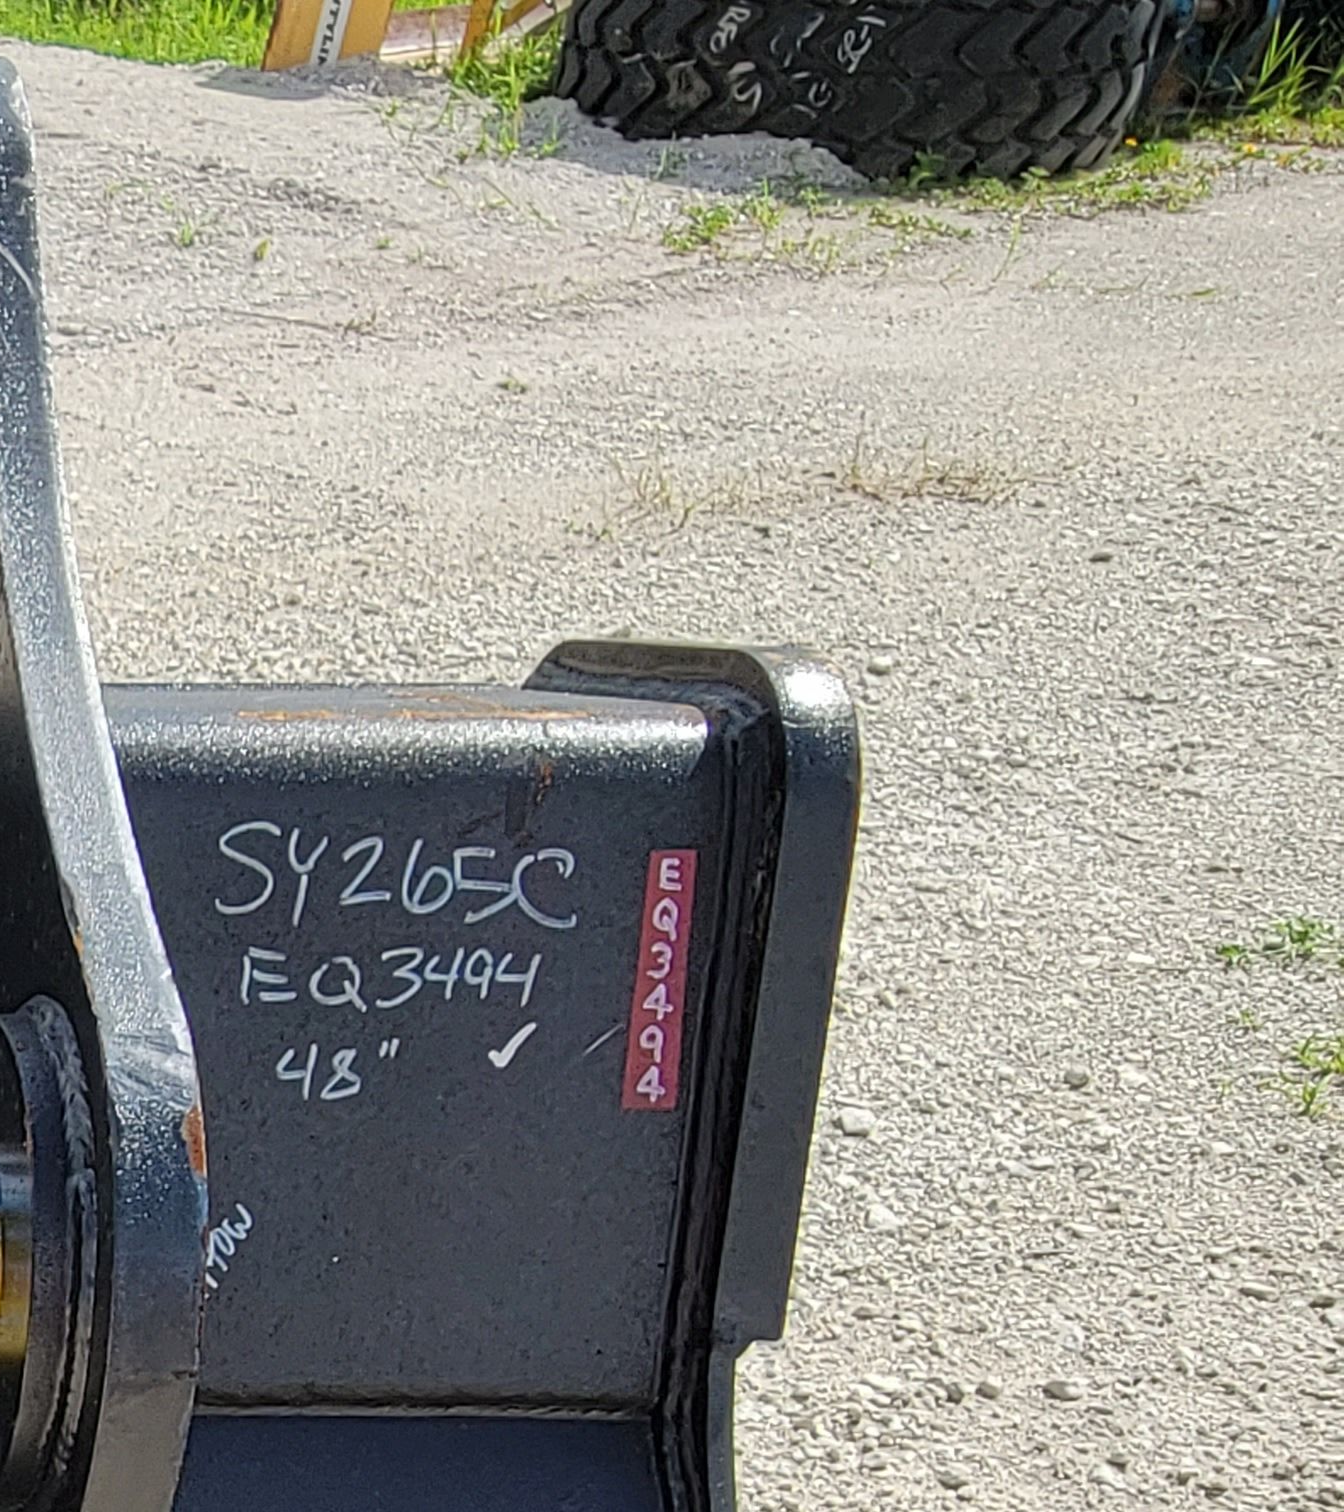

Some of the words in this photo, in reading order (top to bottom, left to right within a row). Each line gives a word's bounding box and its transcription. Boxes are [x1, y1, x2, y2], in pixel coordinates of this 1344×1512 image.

[214, 820, 578, 928] SY265C
[241, 945, 542, 1012] EQ3494
[635, 857, 681, 1103] EQ3494
